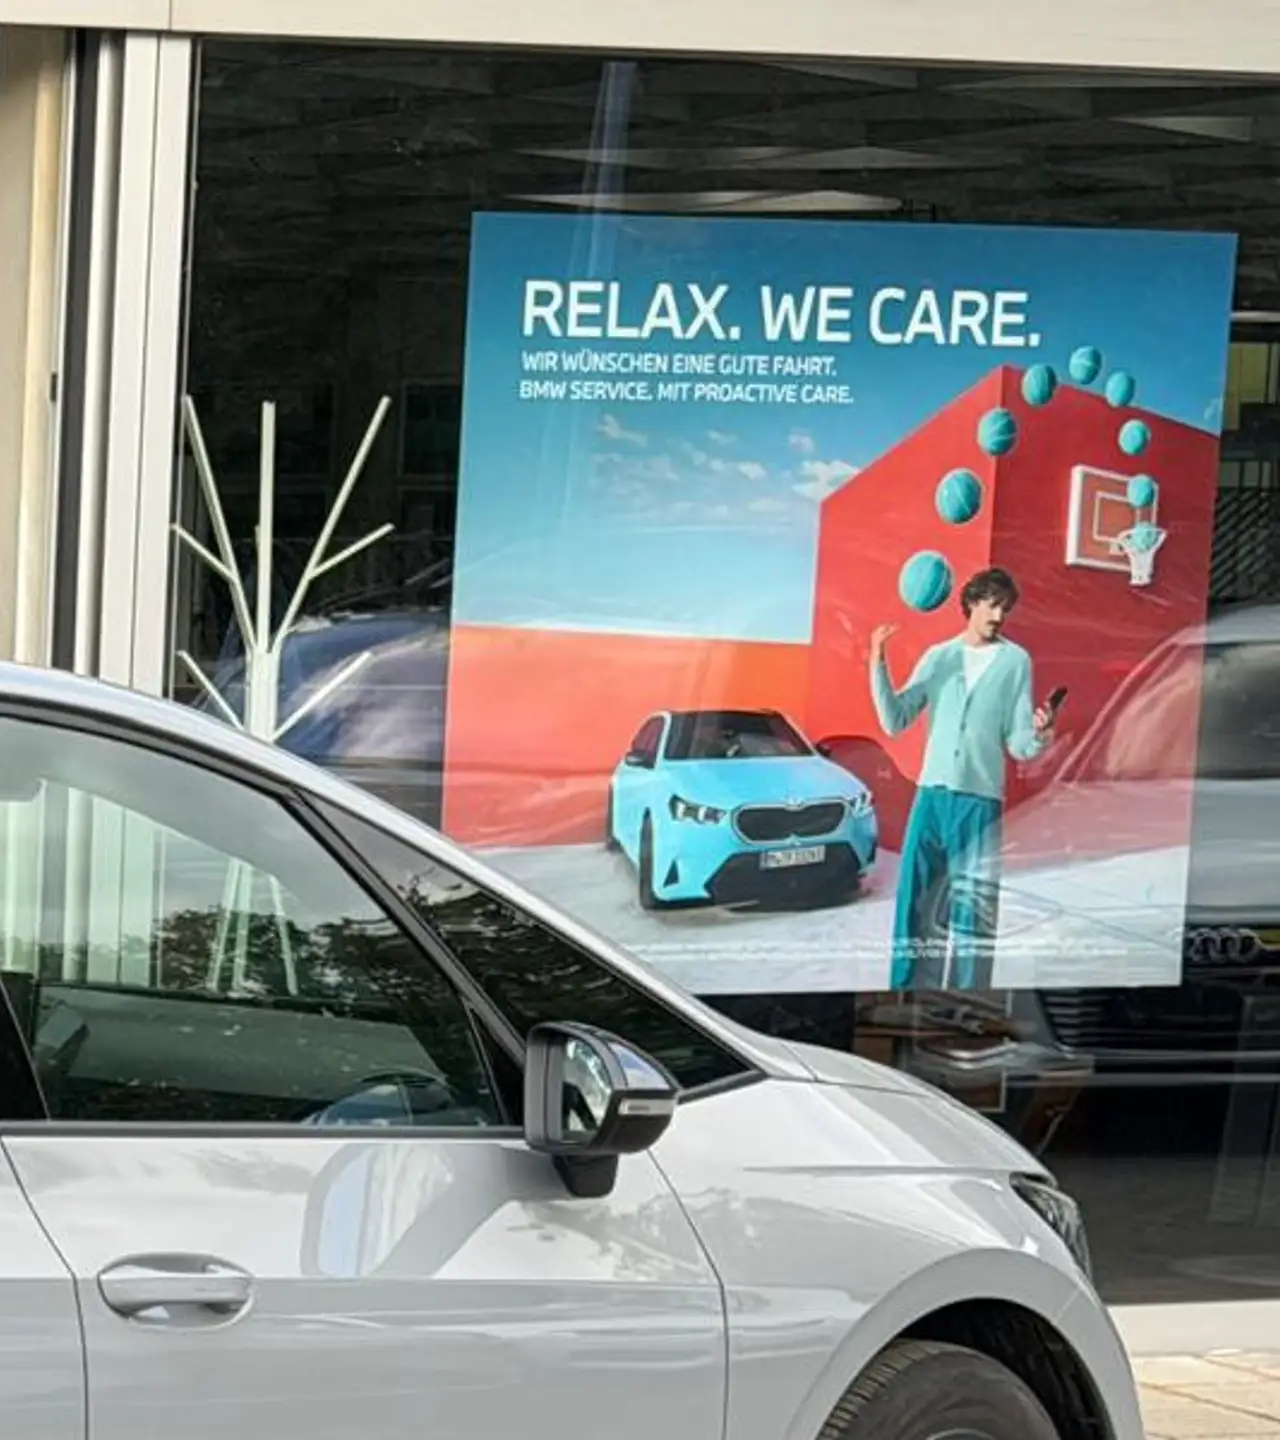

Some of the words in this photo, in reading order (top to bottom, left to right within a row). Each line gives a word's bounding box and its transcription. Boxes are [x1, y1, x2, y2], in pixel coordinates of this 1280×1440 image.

[522, 279, 741, 340] RELAX.
[760, 284, 854, 343] WE
[868, 286, 1041, 348] CARE.
[521, 350, 559, 371] WIR
[561, 347, 669, 375] WÜNSCHEN
[672, 352, 716, 375] EINE
[718, 354, 769, 376] GUTE
[772, 355, 838, 377] FAHRT.
[519, 378, 567, 400] BMW
[569, 380, 653, 402] SERVICE.
[657, 382, 694, 402] MIT
[694, 383, 798, 404] PROACTIVE
[800, 383, 855, 405] CARE.
